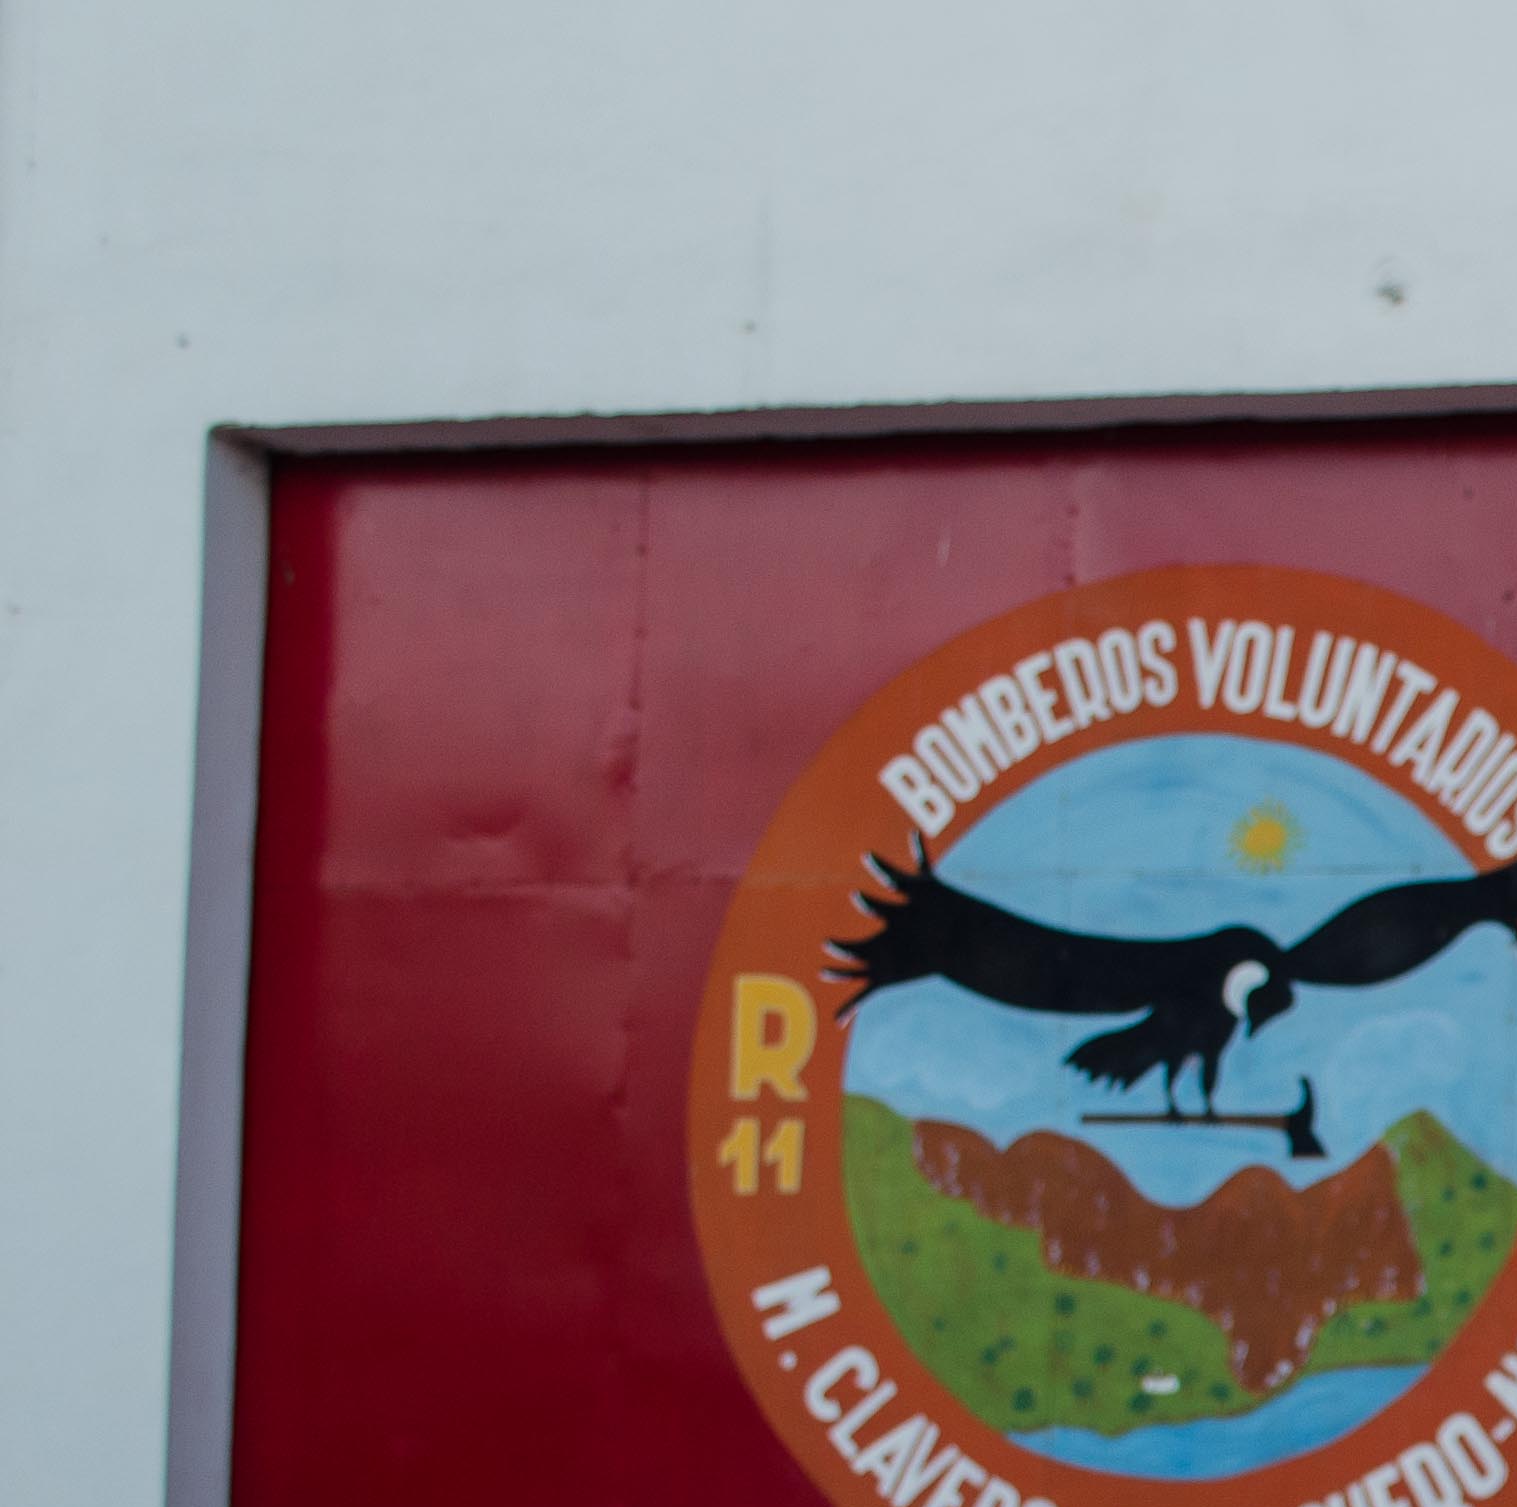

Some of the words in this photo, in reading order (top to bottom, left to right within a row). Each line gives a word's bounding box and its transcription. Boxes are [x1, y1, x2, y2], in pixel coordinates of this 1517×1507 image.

[879, 619, 1178, 838] BOMBEROS
[731, 973, 817, 1101] R
[719, 1117, 804, 1197] 11
